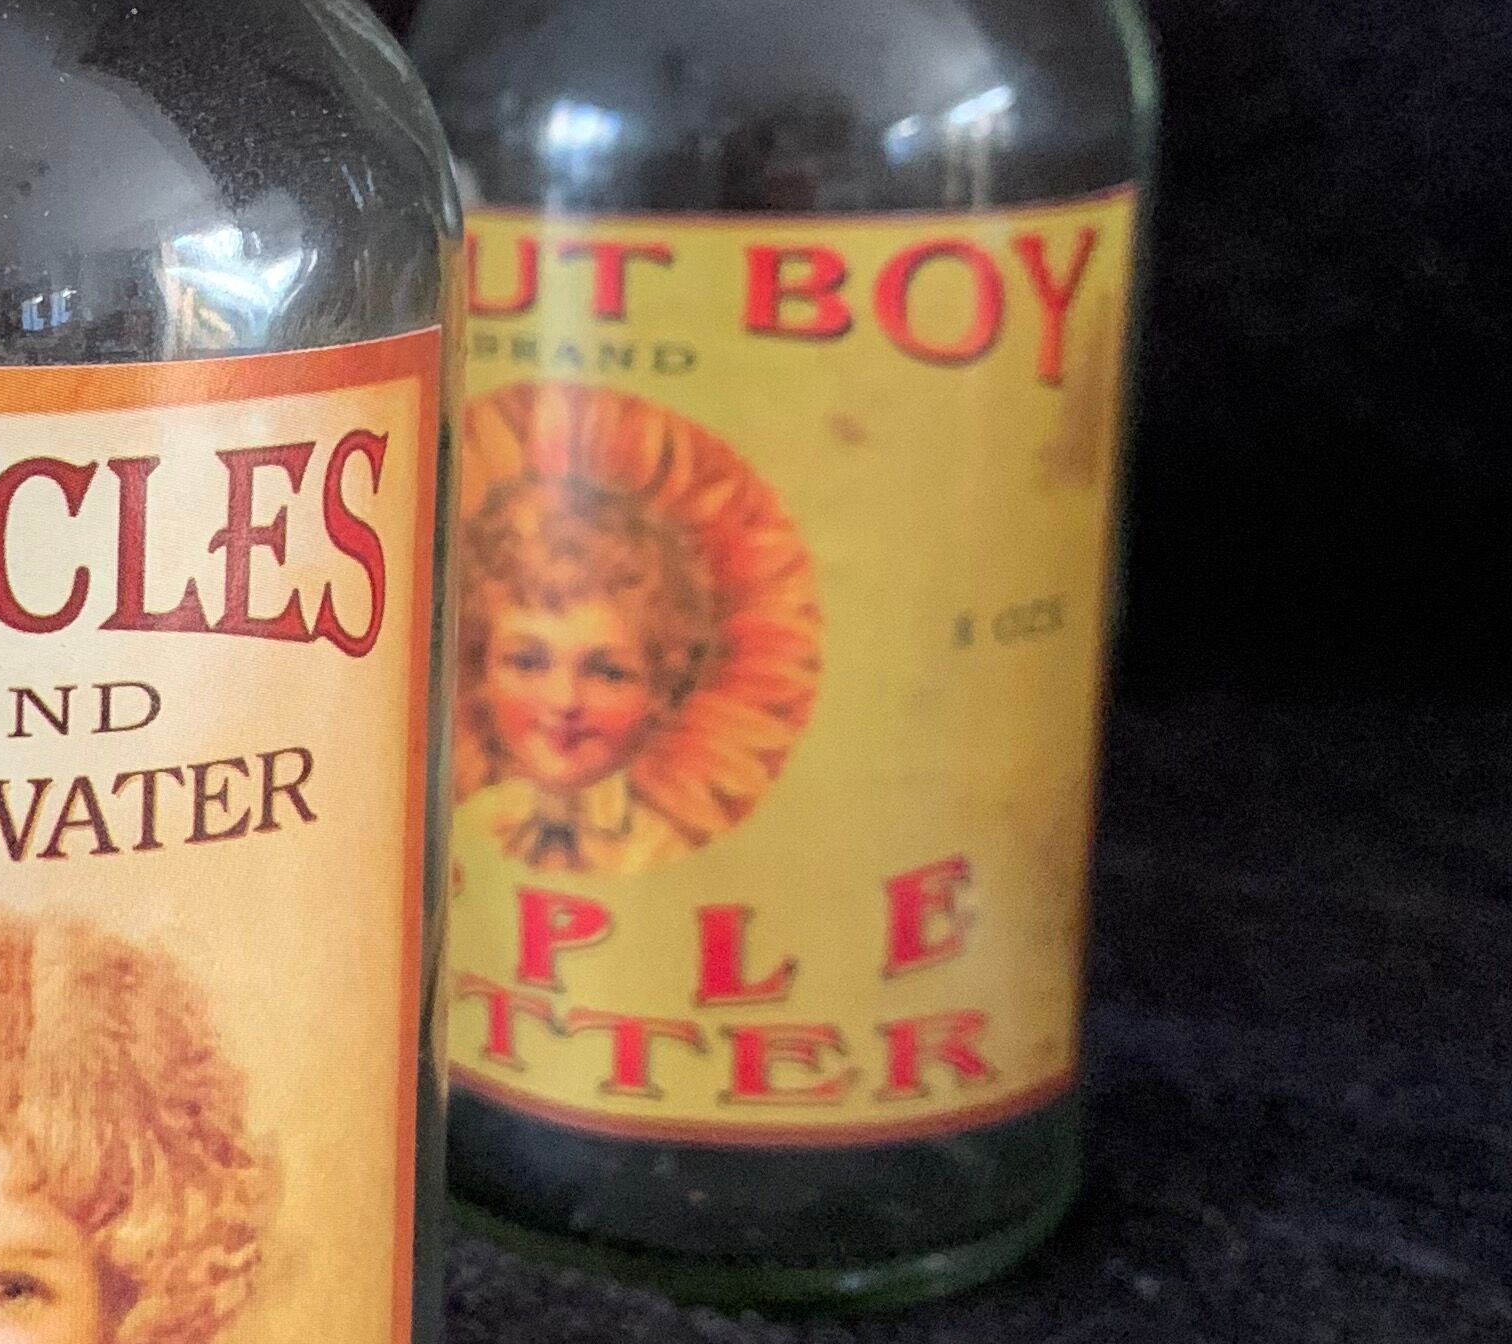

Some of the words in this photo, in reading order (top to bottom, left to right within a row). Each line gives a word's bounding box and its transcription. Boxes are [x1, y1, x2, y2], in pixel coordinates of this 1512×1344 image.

[471, 330, 697, 375] BRAND
[743, 228, 1097, 387] BOY
[452, 856, 978, 1006] PLE
